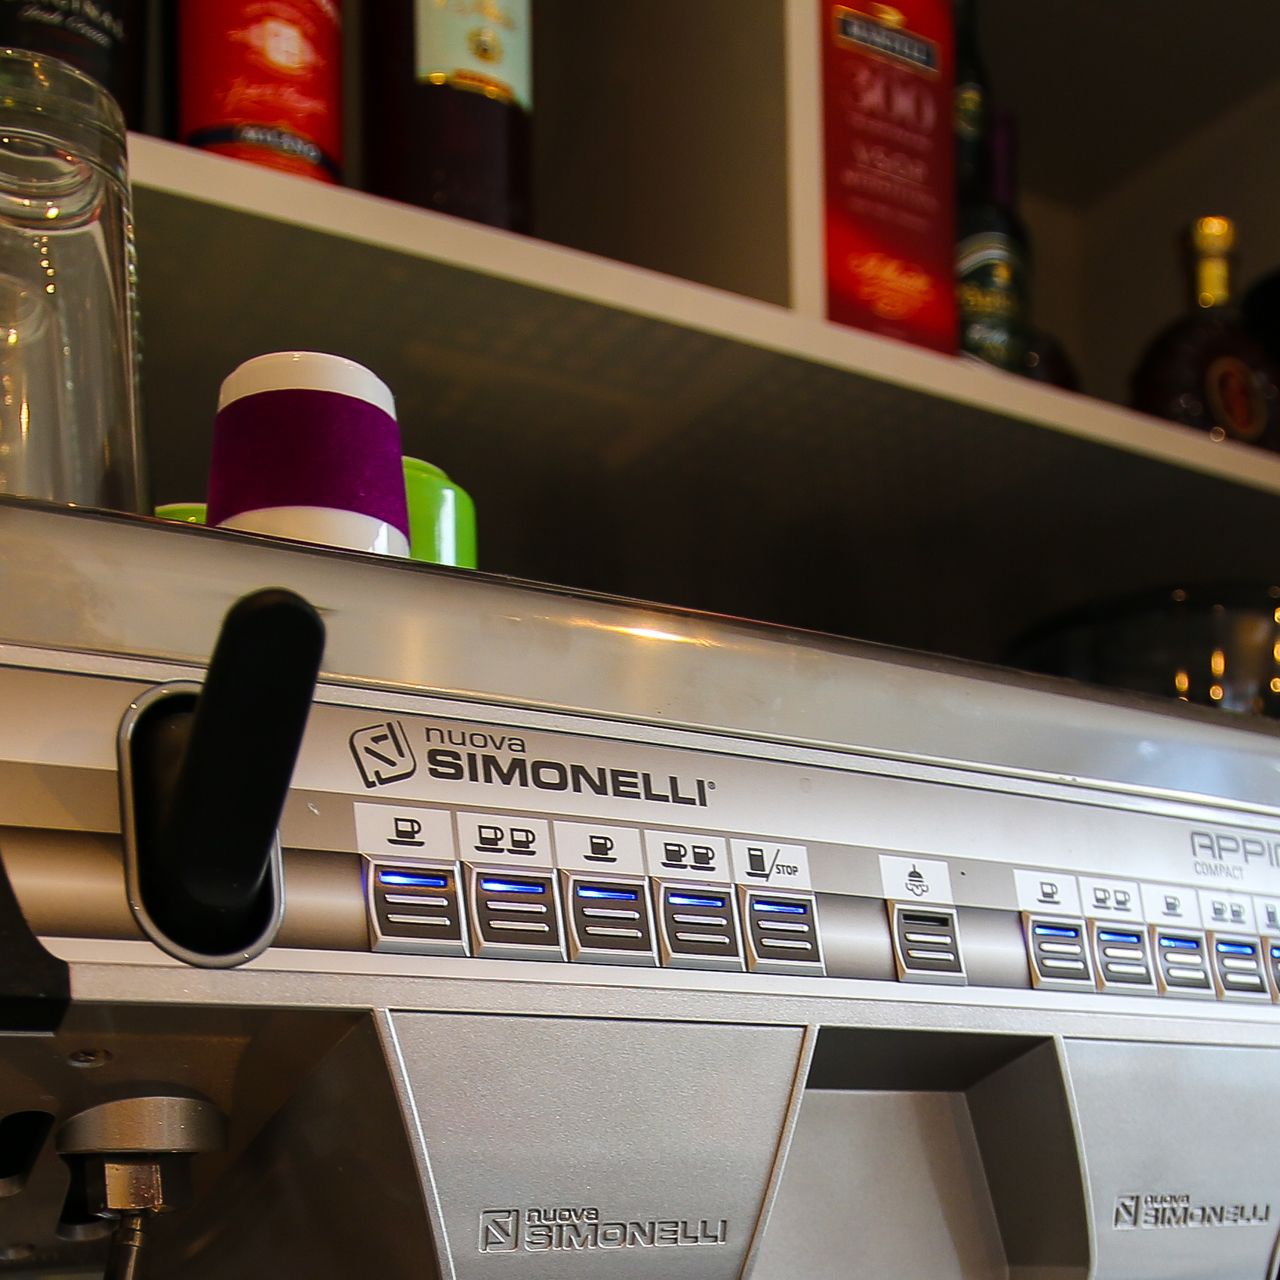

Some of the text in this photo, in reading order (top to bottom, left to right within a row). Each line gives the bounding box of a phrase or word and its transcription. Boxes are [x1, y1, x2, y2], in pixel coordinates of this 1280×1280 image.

[425, 726, 526, 753] nuova
[775, 863, 799, 876] STOP
[1193, 861, 1244, 880] COMPACT
[1142, 1194, 1190, 1208] nuova
[524, 1207, 600, 1224] nuova
[1141, 1203, 1270, 1229] SIMONELLI
[524, 1219, 728, 1252] SIMONELLI
